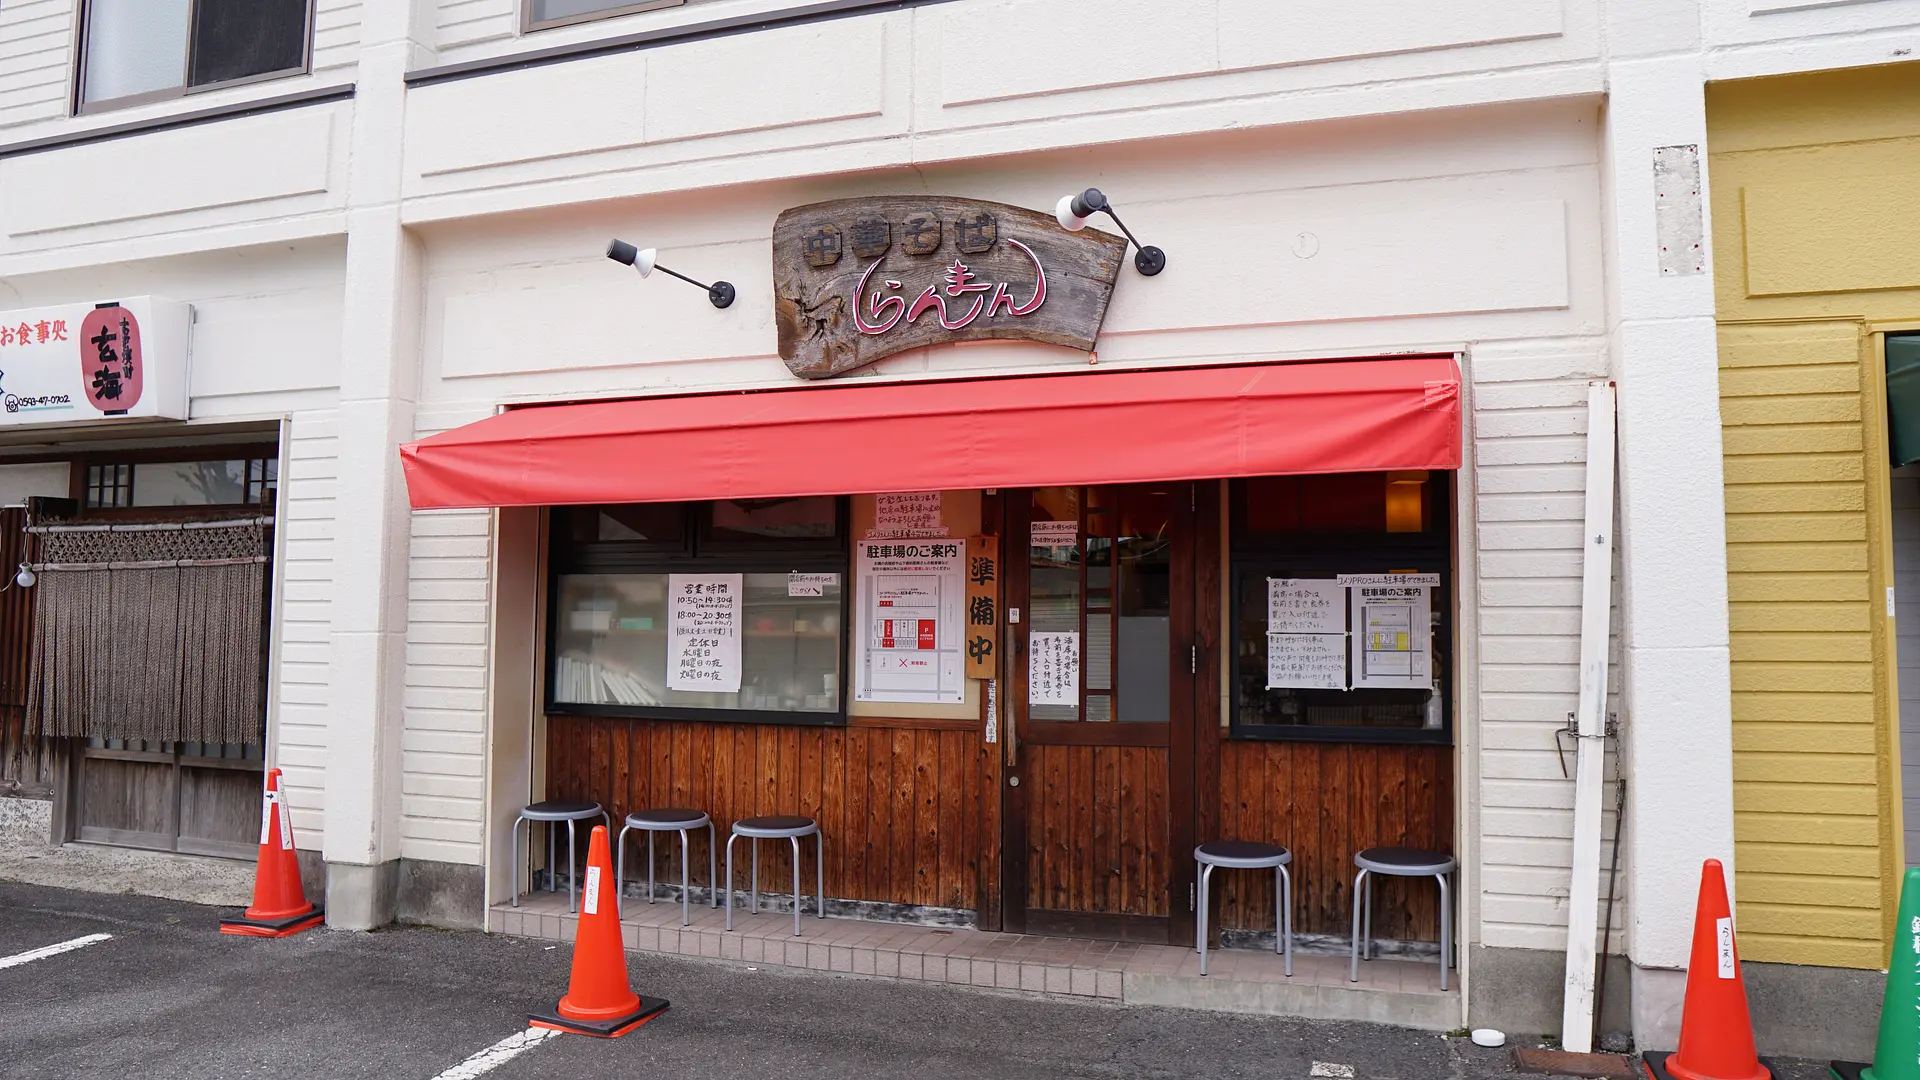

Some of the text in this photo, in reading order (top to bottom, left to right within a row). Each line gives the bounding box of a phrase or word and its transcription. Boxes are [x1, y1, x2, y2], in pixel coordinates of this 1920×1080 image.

[808, 212, 998, 263] 中華そば
[853, 238, 1047, 335] らんまん
[0, 320, 68, 347] お食事処
[91, 325, 123, 401] 玄海
[19, 394, 71, 407] 0593-47-0702
[866, 545, 957, 558] 駐車場のご案内
[685, 583, 728, 595] 営業時間
[1361, 588, 1422, 597] 駐車場のご案内
[969, 556, 995, 665] 準備中
[688, 637, 719, 648] 定休日
[682, 648, 711, 658] 水曜日
[680, 657, 723, 669] 月曜日の夜
[679, 669, 722, 681] 火曜日の夜
